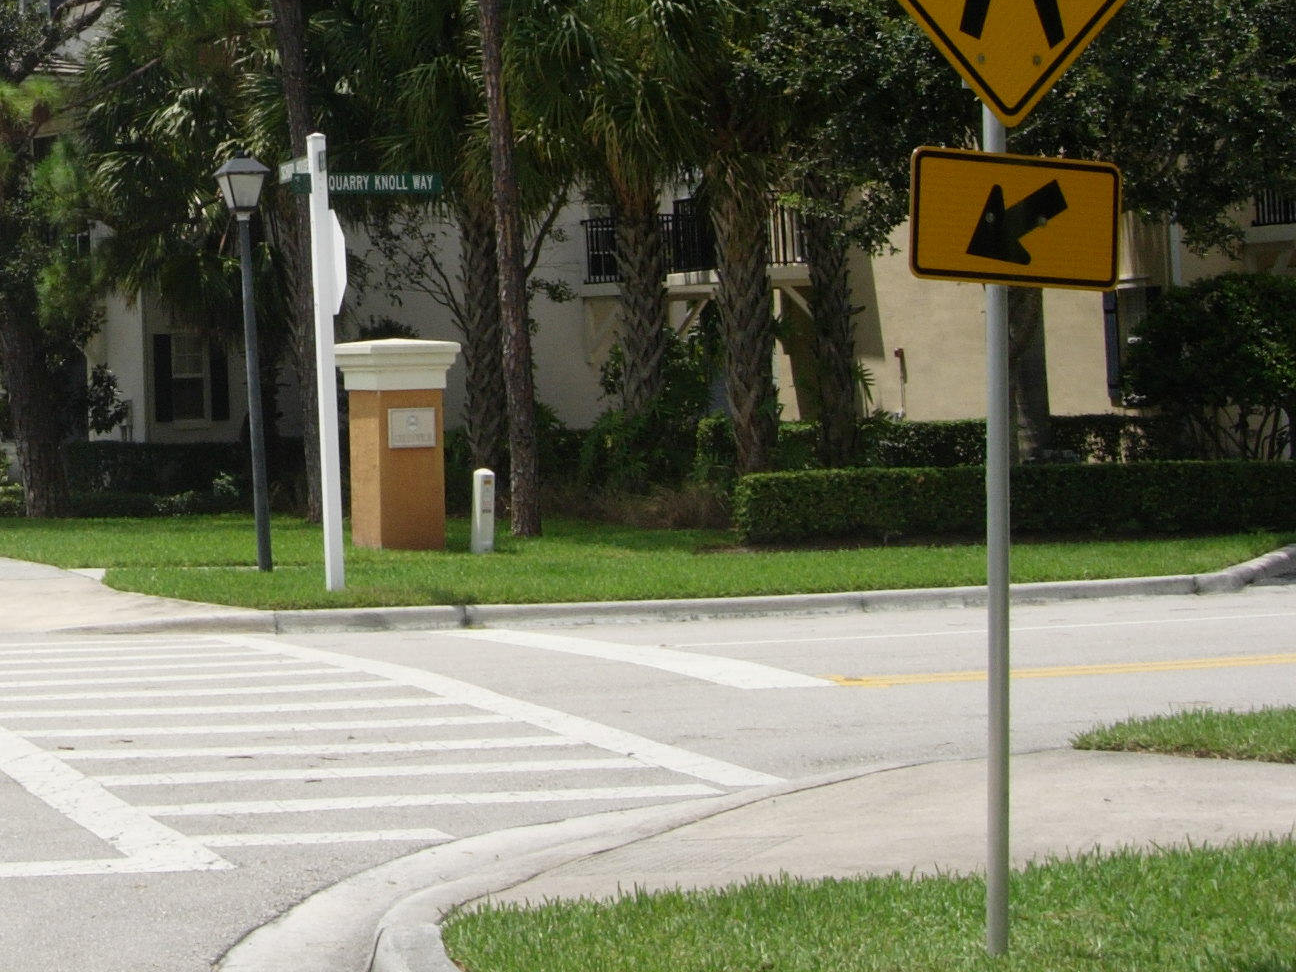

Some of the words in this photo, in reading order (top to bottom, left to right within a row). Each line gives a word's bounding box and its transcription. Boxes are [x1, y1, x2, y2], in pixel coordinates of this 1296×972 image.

[328, 175, 369, 191] QUARRY
[374, 175, 408, 191] KNOLL
[413, 175, 433, 190] WAY
